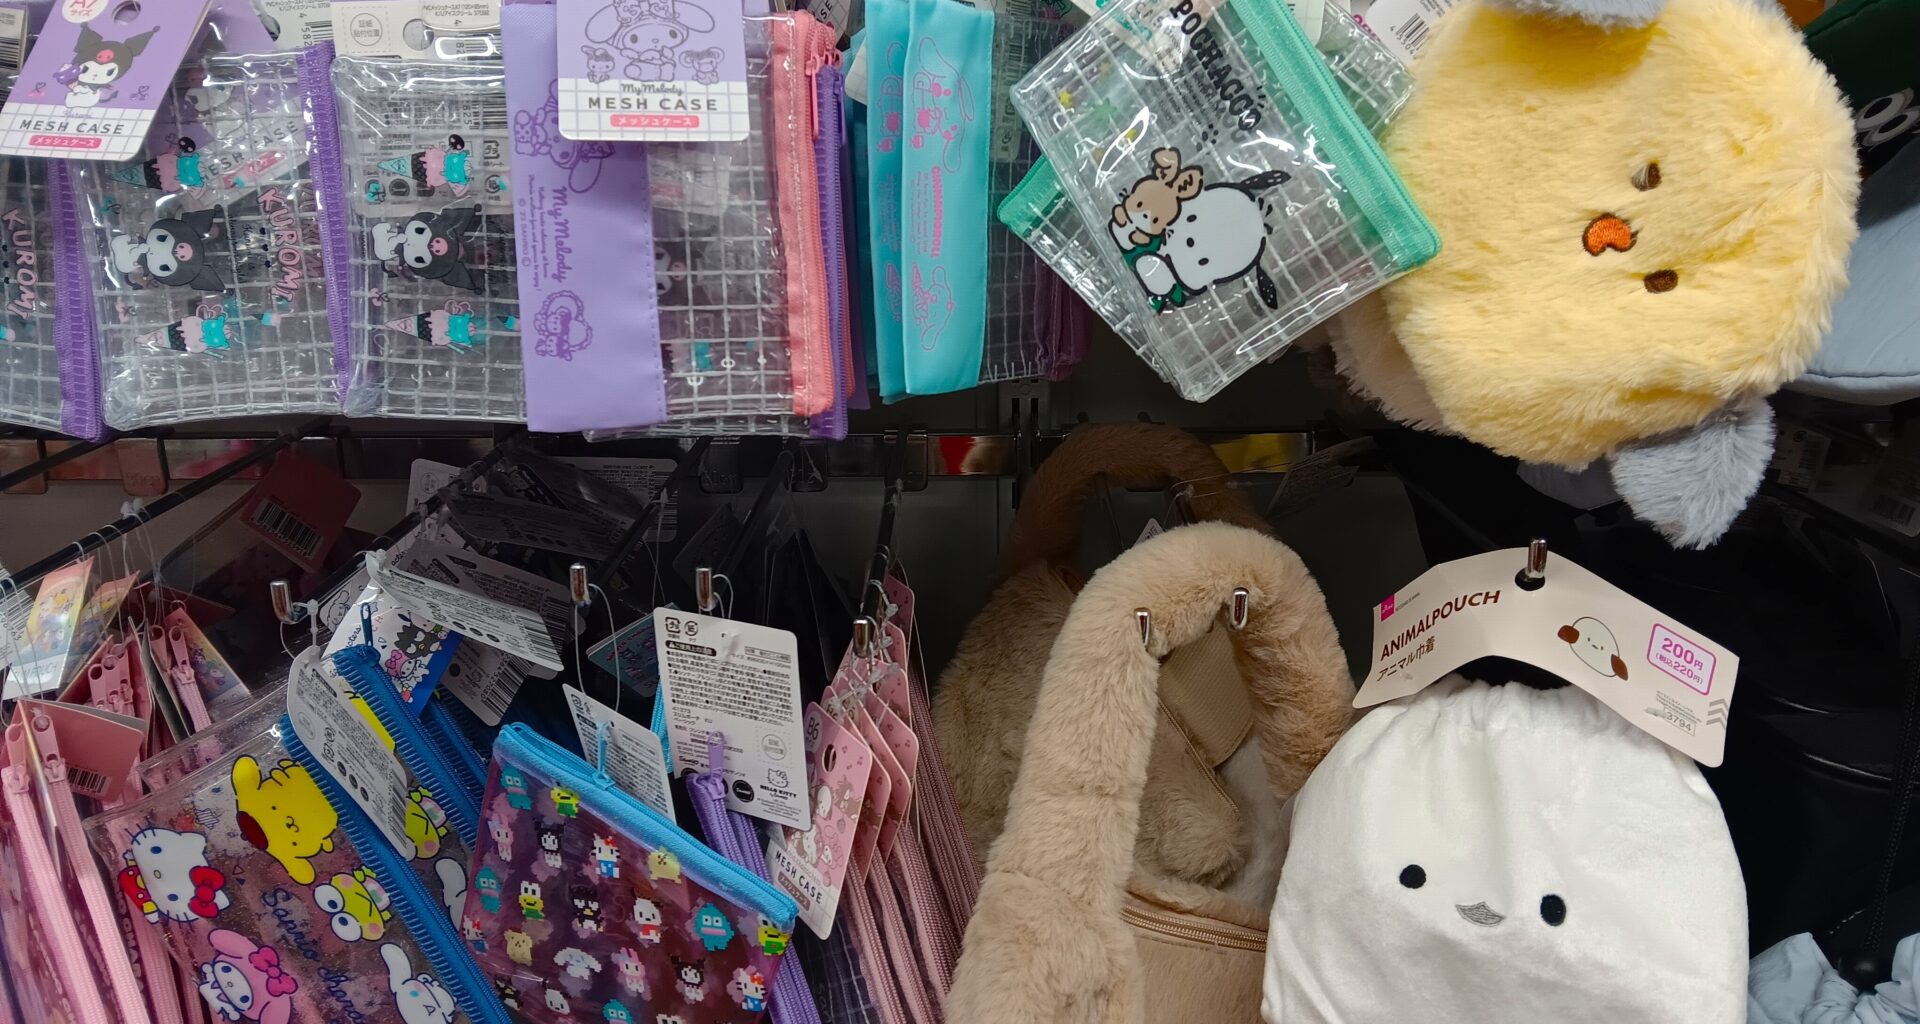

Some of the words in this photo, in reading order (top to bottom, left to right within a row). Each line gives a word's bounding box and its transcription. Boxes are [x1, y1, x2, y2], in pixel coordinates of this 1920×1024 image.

[1169, 0, 1262, 131] POCHACCO
[588, 97, 648, 110] MESH
[659, 98, 718, 111] CASE
[620, 83, 641, 96] My
[642, 83, 684, 97] Melody
[20, 119, 69, 133] MESH
[76, 122, 125, 135] CASE
[617, 116, 693, 126] メッシュケース
[34, 137, 96, 147] メッシュケース
[547, 186, 569, 220] My
[257, 187, 302, 303] KUROMI
[551, 219, 573, 283] Melody
[2, 208, 39, 320] KUROMI
[1380, 590, 1501, 662] ANIMALPOUCH
[1377, 635, 1435, 681] アニマル巾着
[1655, 652, 1704, 685] (税込220円)
[1661, 637, 1704, 671] 200円
[807, 717, 820, 741] B6
[760, 785, 779, 793] HELLO
[779, 788, 798, 798] KITTY
[775, 850, 797, 878] MESH
[797, 873, 823, 905] CASE
[262, 887, 321, 962] Sanrio
